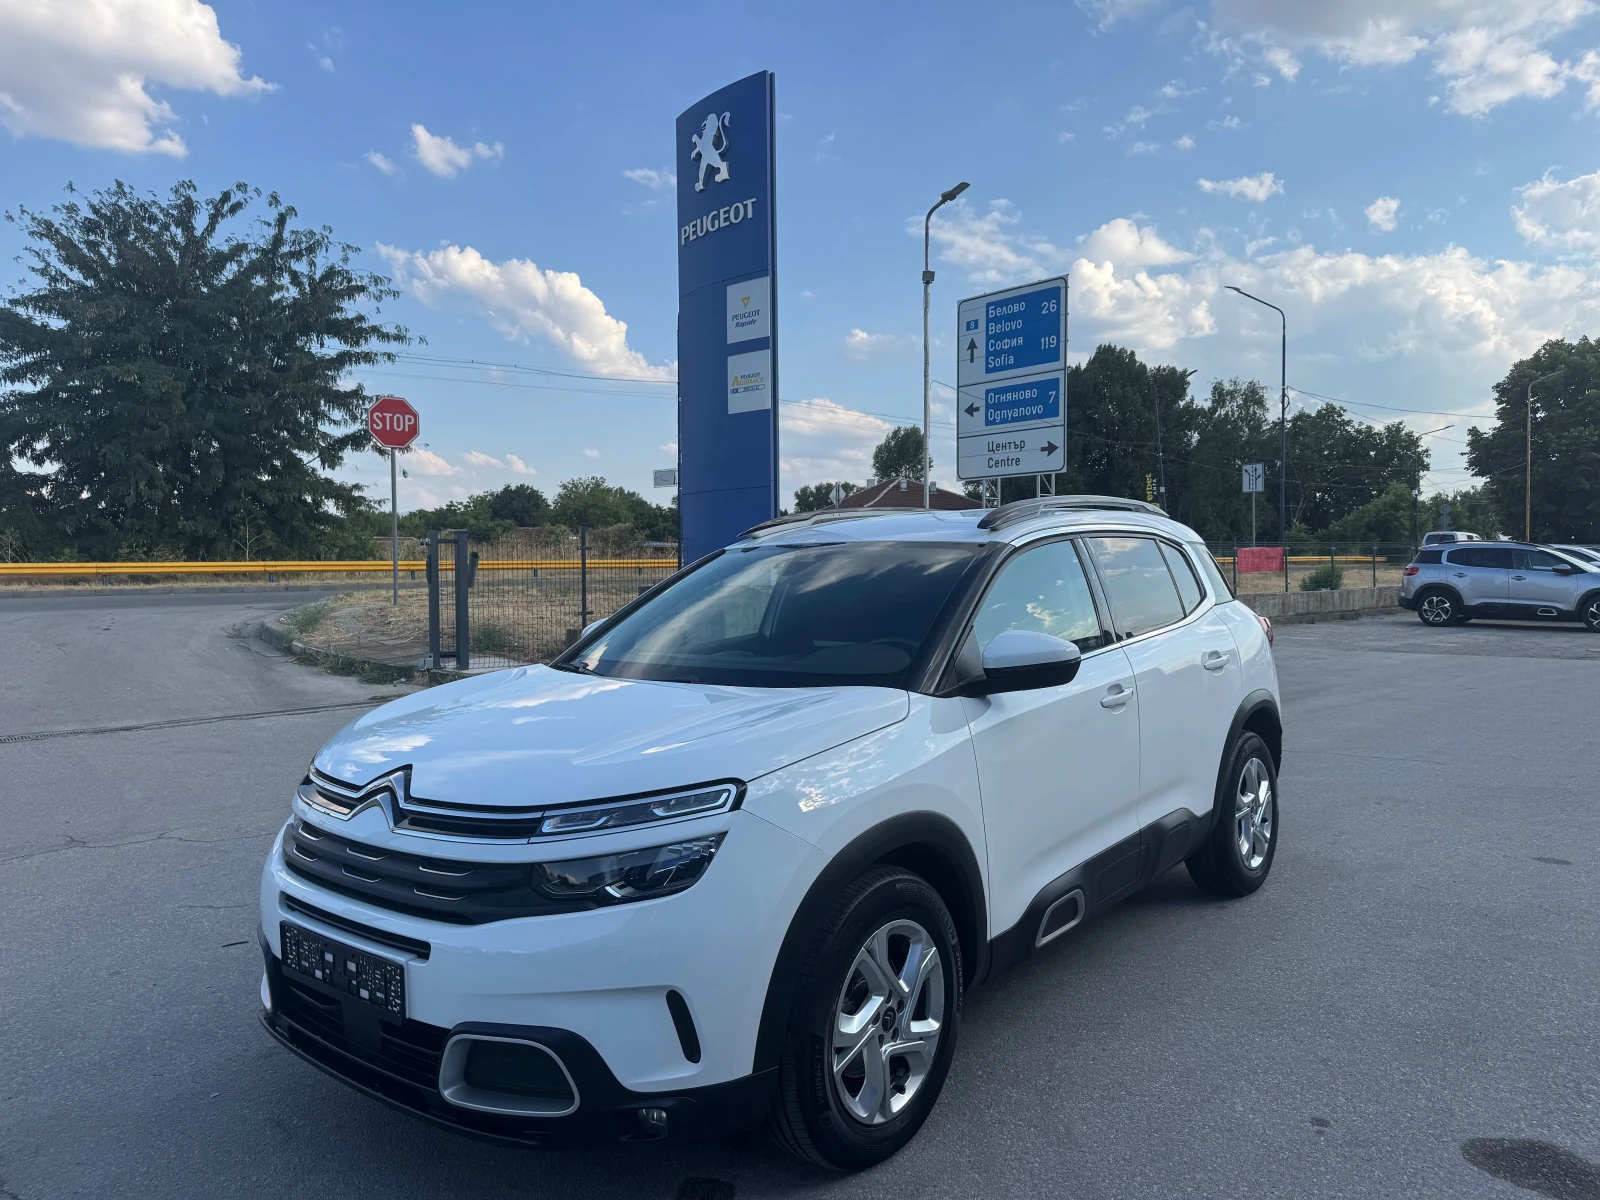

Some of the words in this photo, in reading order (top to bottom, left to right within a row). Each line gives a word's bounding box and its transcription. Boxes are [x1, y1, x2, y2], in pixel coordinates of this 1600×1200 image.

[681, 197, 757, 246] PEUGEOT
[731, 308, 761, 322] PEUGEOT
[988, 301, 1026, 318] Белово
[1041, 299, 1057, 315] 26
[969, 321, 975, 330] 8
[988, 319, 1023, 335] Belovo
[988, 336, 1024, 352] София
[1040, 335, 1057, 350] 119
[988, 353, 1014, 368] Sofia
[988, 388, 1038, 404] Огняново
[1048, 390, 1057, 404] 7
[988, 404, 1044, 422] Ognyanovo
[372, 411, 415, 432] STOP
[987, 440, 1026, 454] Център
[987, 456, 1021, 469] Centre
[1145, 472, 1153, 501] efbet
[814, 1053, 824, 1104] PRIMACY
